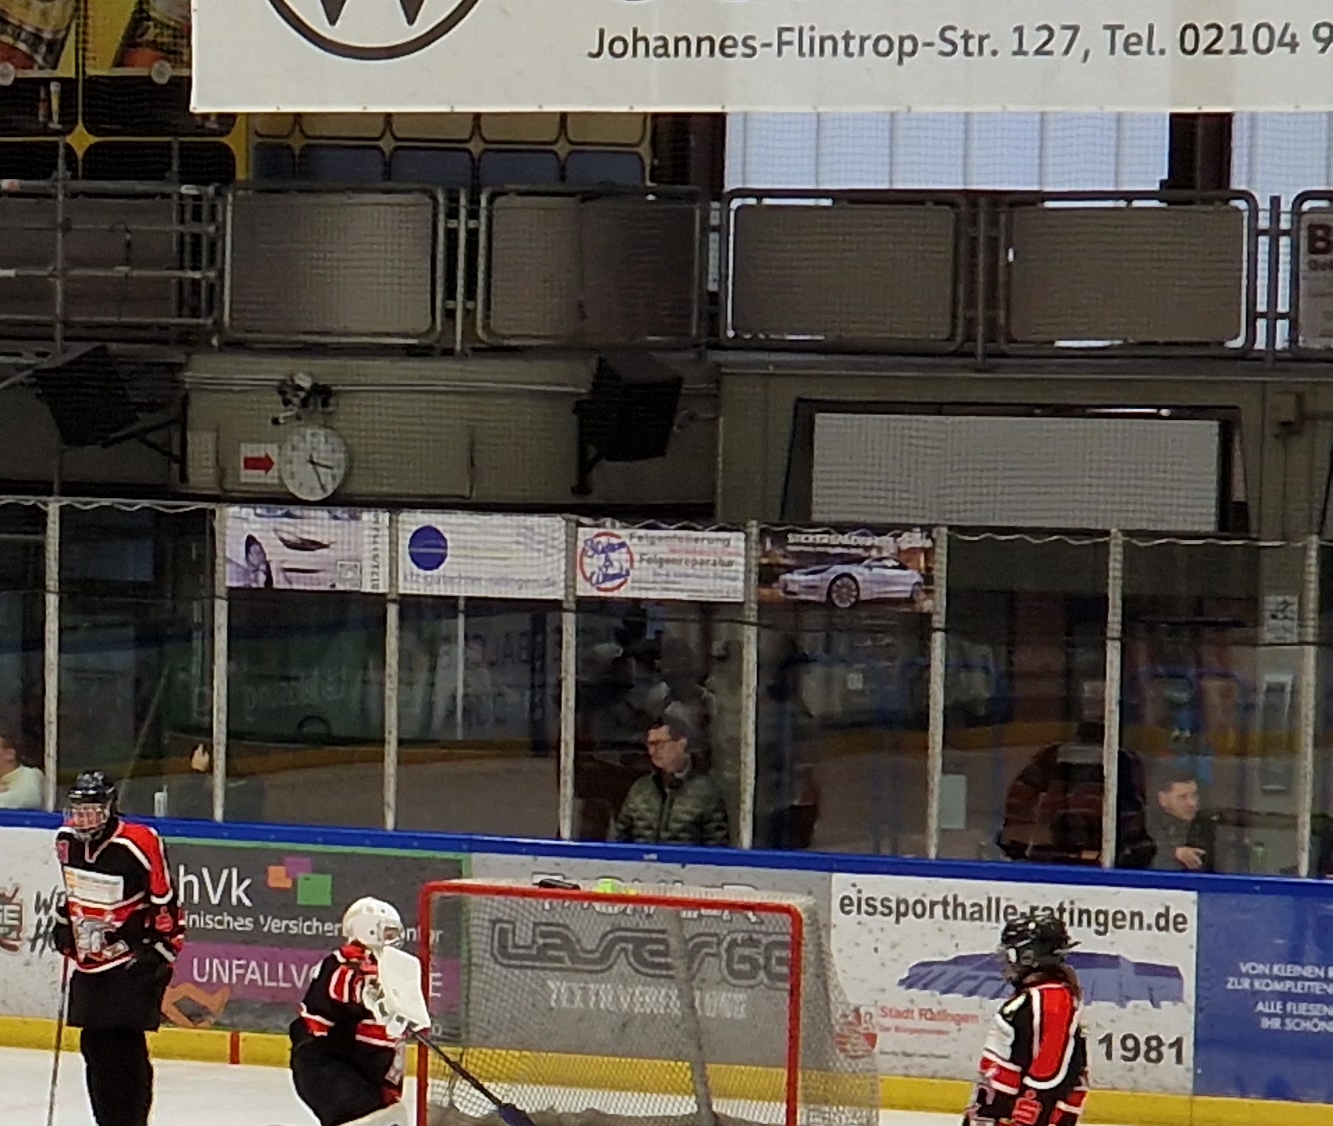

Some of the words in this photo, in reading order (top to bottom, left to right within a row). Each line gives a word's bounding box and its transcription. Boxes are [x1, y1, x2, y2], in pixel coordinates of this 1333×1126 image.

[587, 25, 1000, 66] Johannes-Flintrop-Str.
[1010, 25, 1091, 63] 127,
[1101, 24, 1167, 57] Tel.
[1178, 23, 1300, 57] 02104
[839, 890, 1189, 937] eissporthalle-ratingen.de
[879, 1004, 915, 1020] Stadt
[918, 1007, 980, 1025] Ratingen
[1098, 1032, 1186, 1066] 1981
